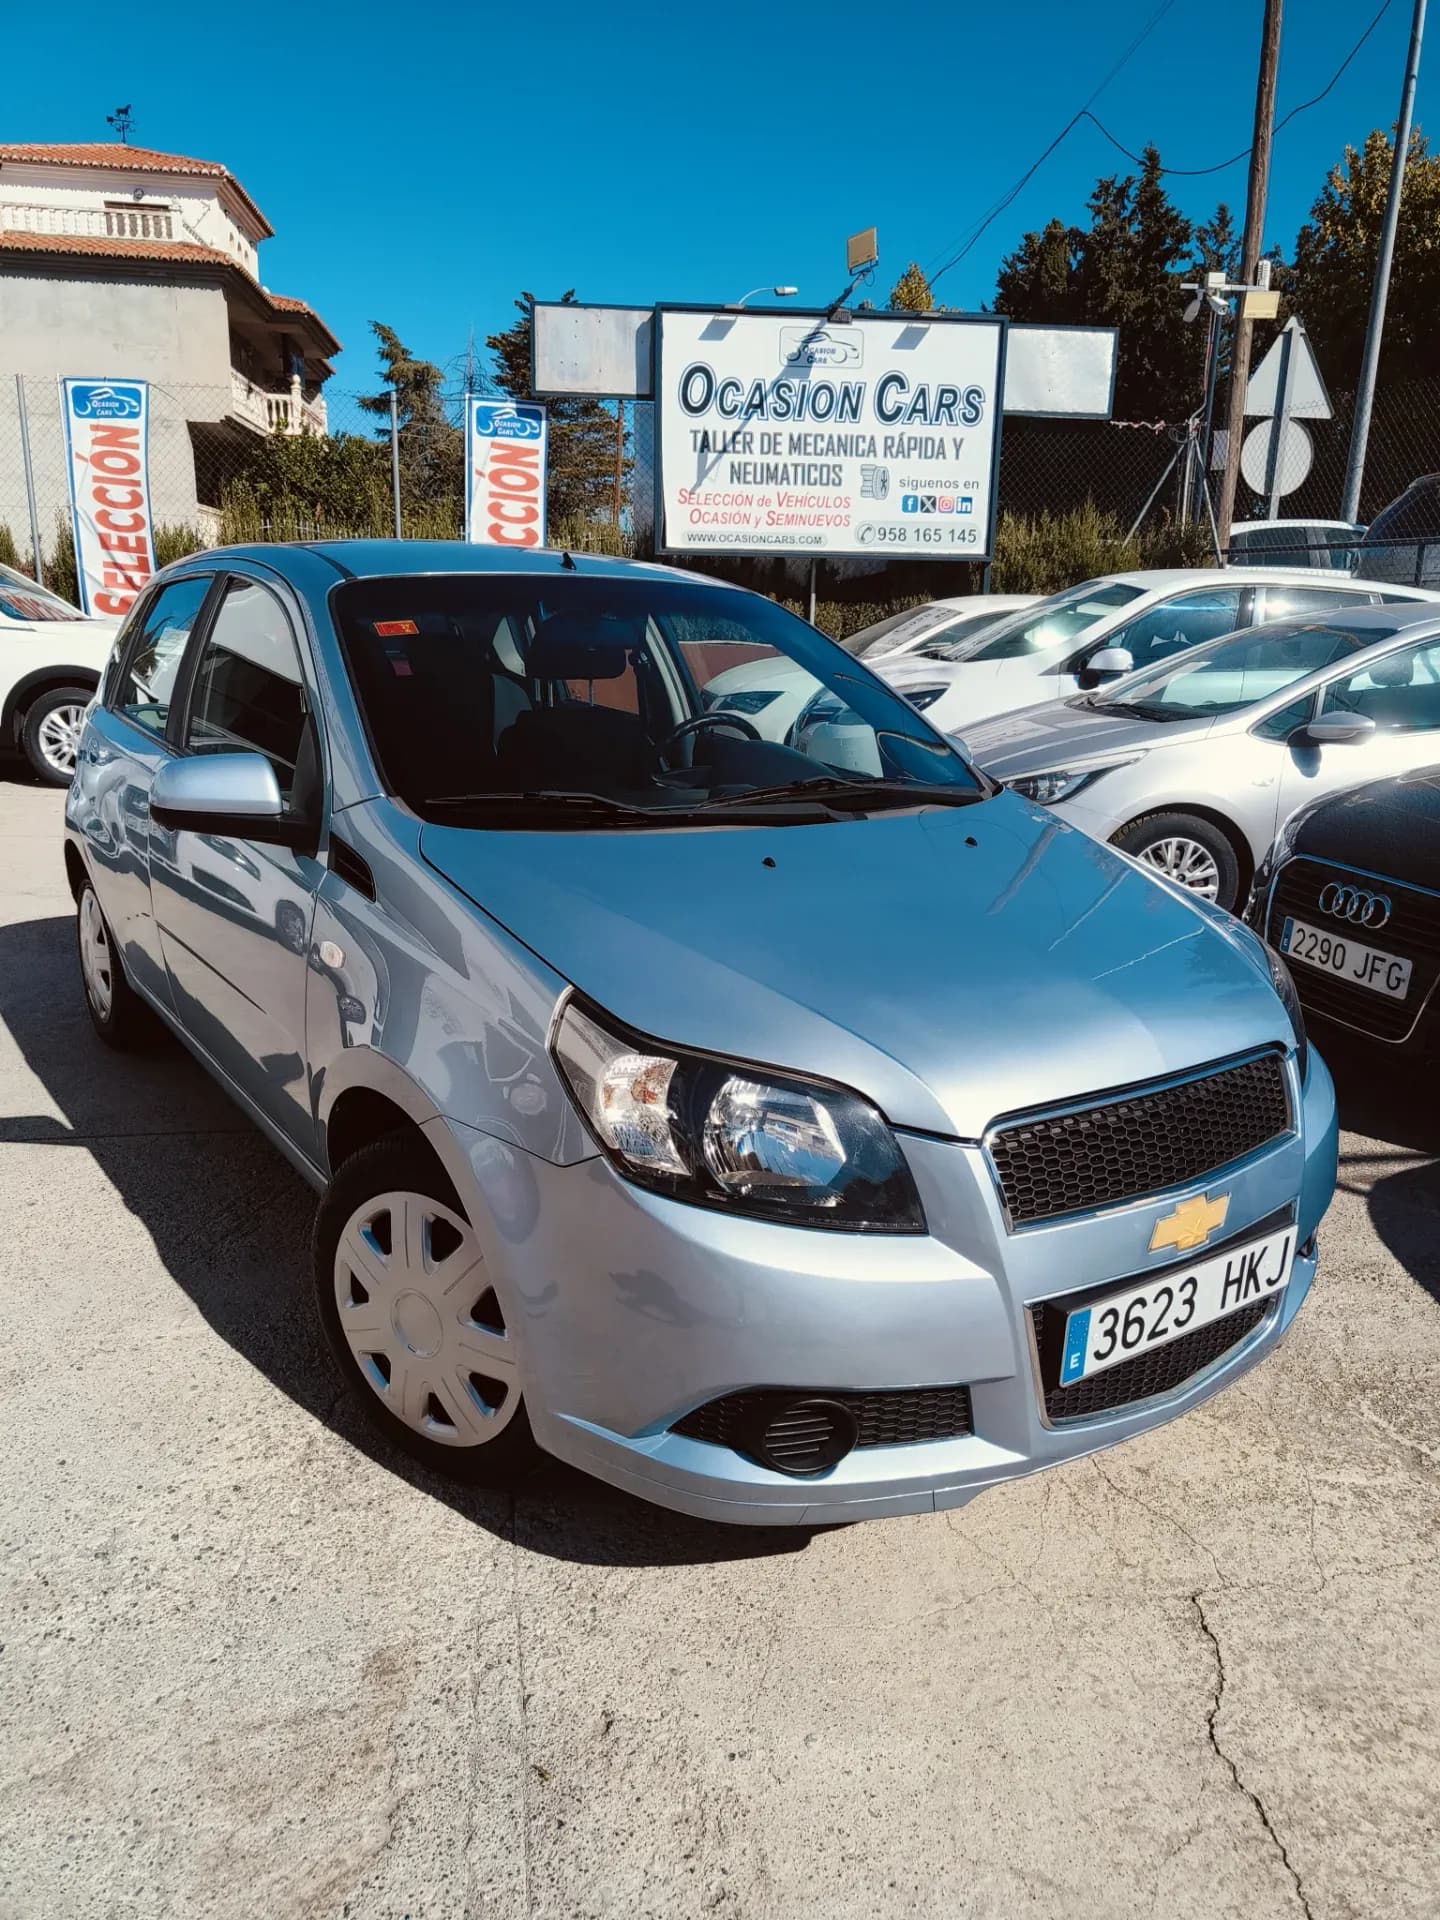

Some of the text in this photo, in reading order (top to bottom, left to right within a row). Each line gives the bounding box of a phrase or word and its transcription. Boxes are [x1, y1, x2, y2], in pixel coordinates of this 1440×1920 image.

[678, 361, 986, 427] OCASION CARS
[689, 429, 965, 461] TALLER DE MECANICA RÁPIDA Y
[729, 461, 843, 487] NEUMATICOS
[963, 480, 980, 490] en
[677, 488, 852, 509] SELECCIÓN de VEHÍCULOS
[689, 508, 851, 528] OCASIÓN y SEMINUEVOS
[687, 534, 822, 545] WWW.OCASIONCARS.COM
[877, 527, 977, 543] 958 165 145
[1293, 928, 1346, 970] 2290
[1353, 952, 1404, 991] JFG
[1069, 1236, 1290, 1369] E 3623 HKJ
